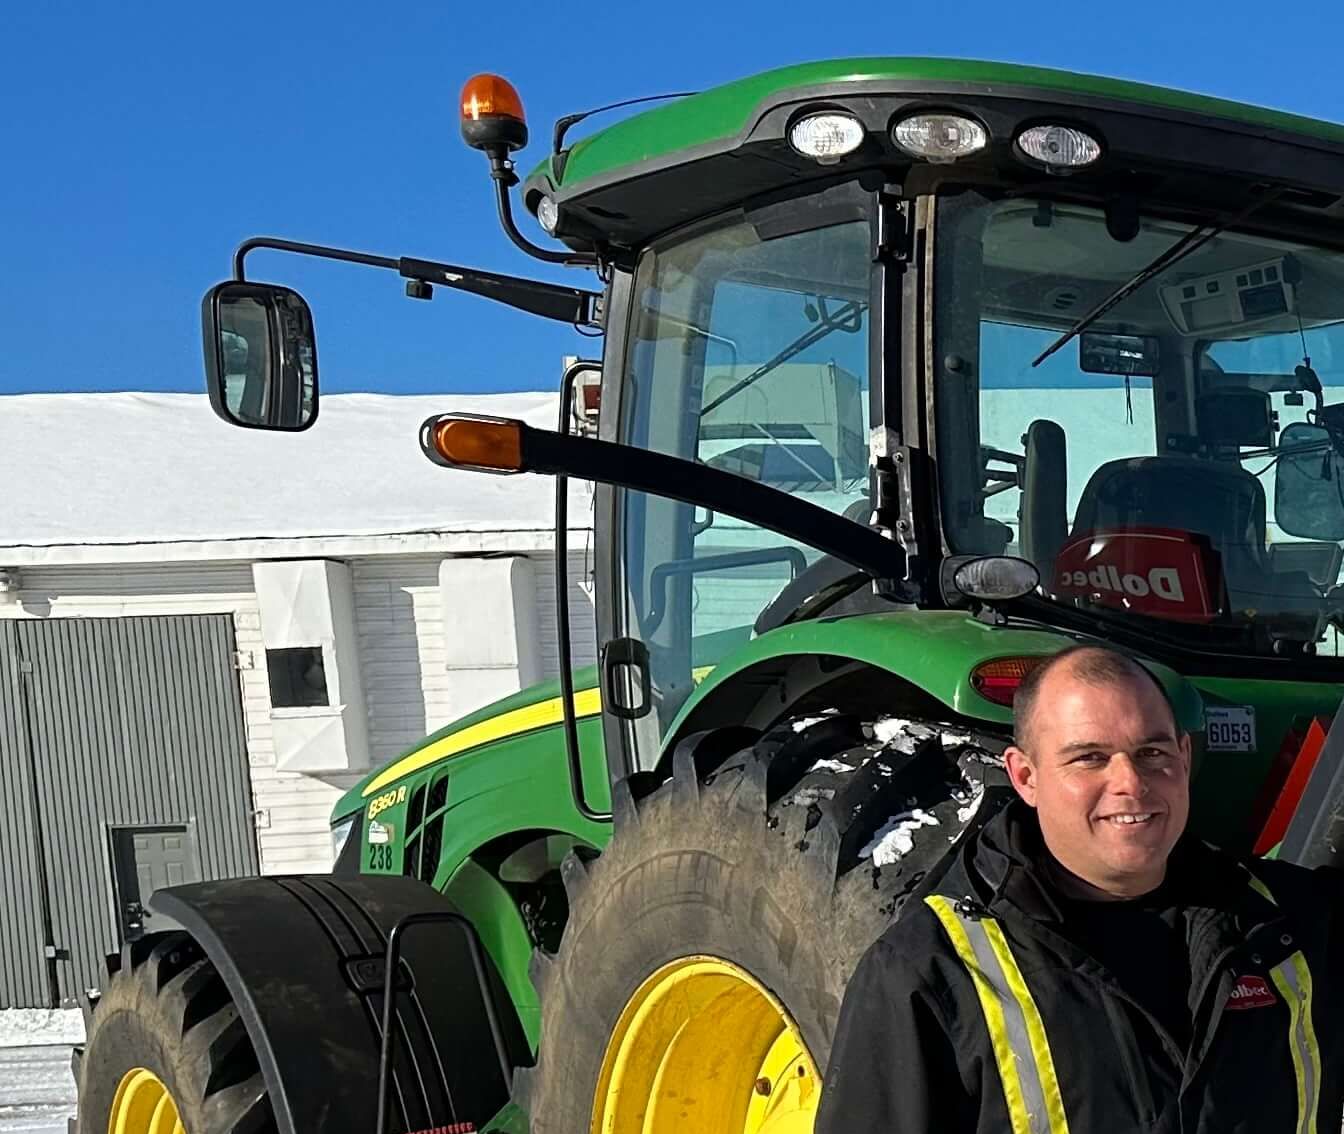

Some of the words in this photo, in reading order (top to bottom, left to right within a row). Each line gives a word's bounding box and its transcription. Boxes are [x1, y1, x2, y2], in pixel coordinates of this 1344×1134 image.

[1210, 723, 1251, 743] 6053
[369, 845, 393, 870] 238
[1231, 984, 1268, 999] olbec
